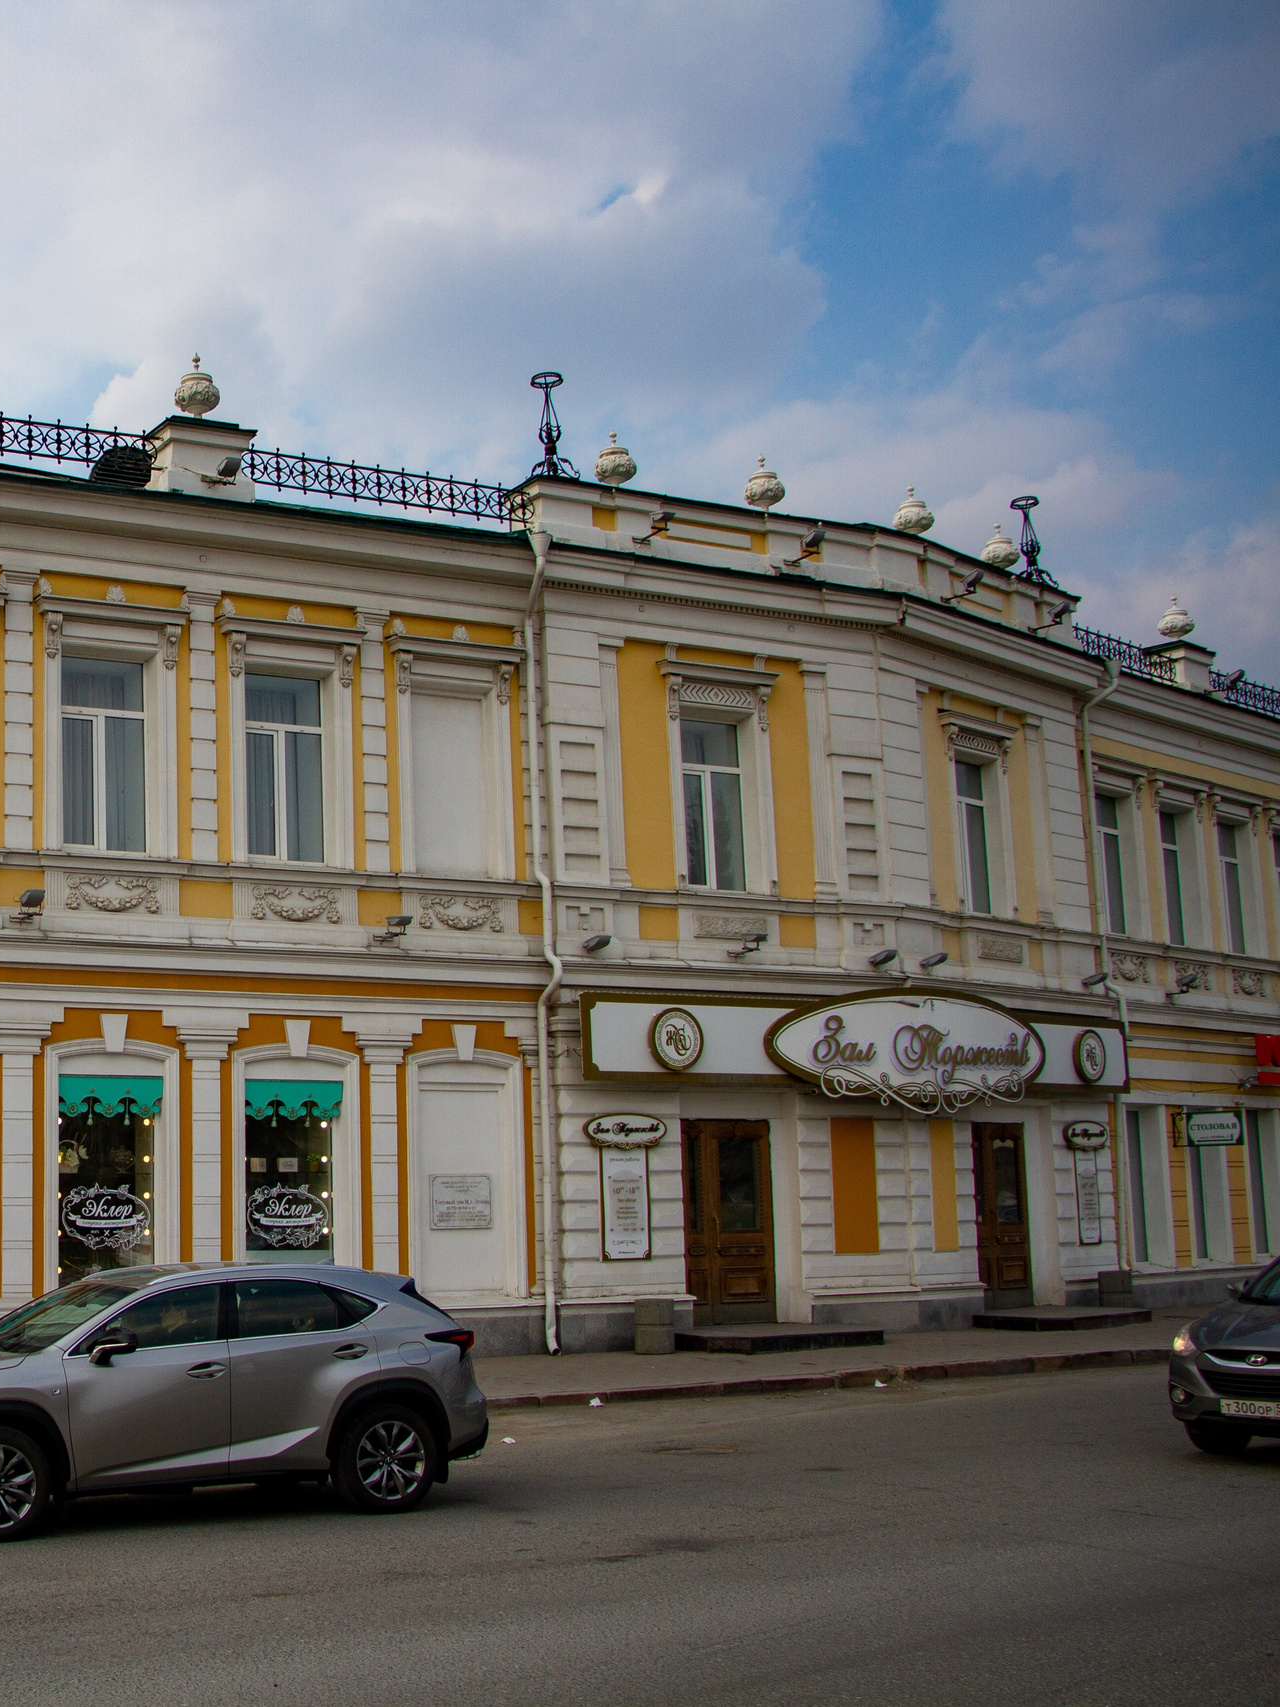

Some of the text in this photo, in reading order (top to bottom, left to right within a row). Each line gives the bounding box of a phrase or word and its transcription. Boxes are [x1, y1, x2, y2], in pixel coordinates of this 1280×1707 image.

[812, 1014, 878, 1066] Зал
[1190, 1122, 1237, 1131] СТОЛОВАЯ
[81, 1195, 133, 1220] Эклер
[265, 1195, 312, 1219] Эклер
